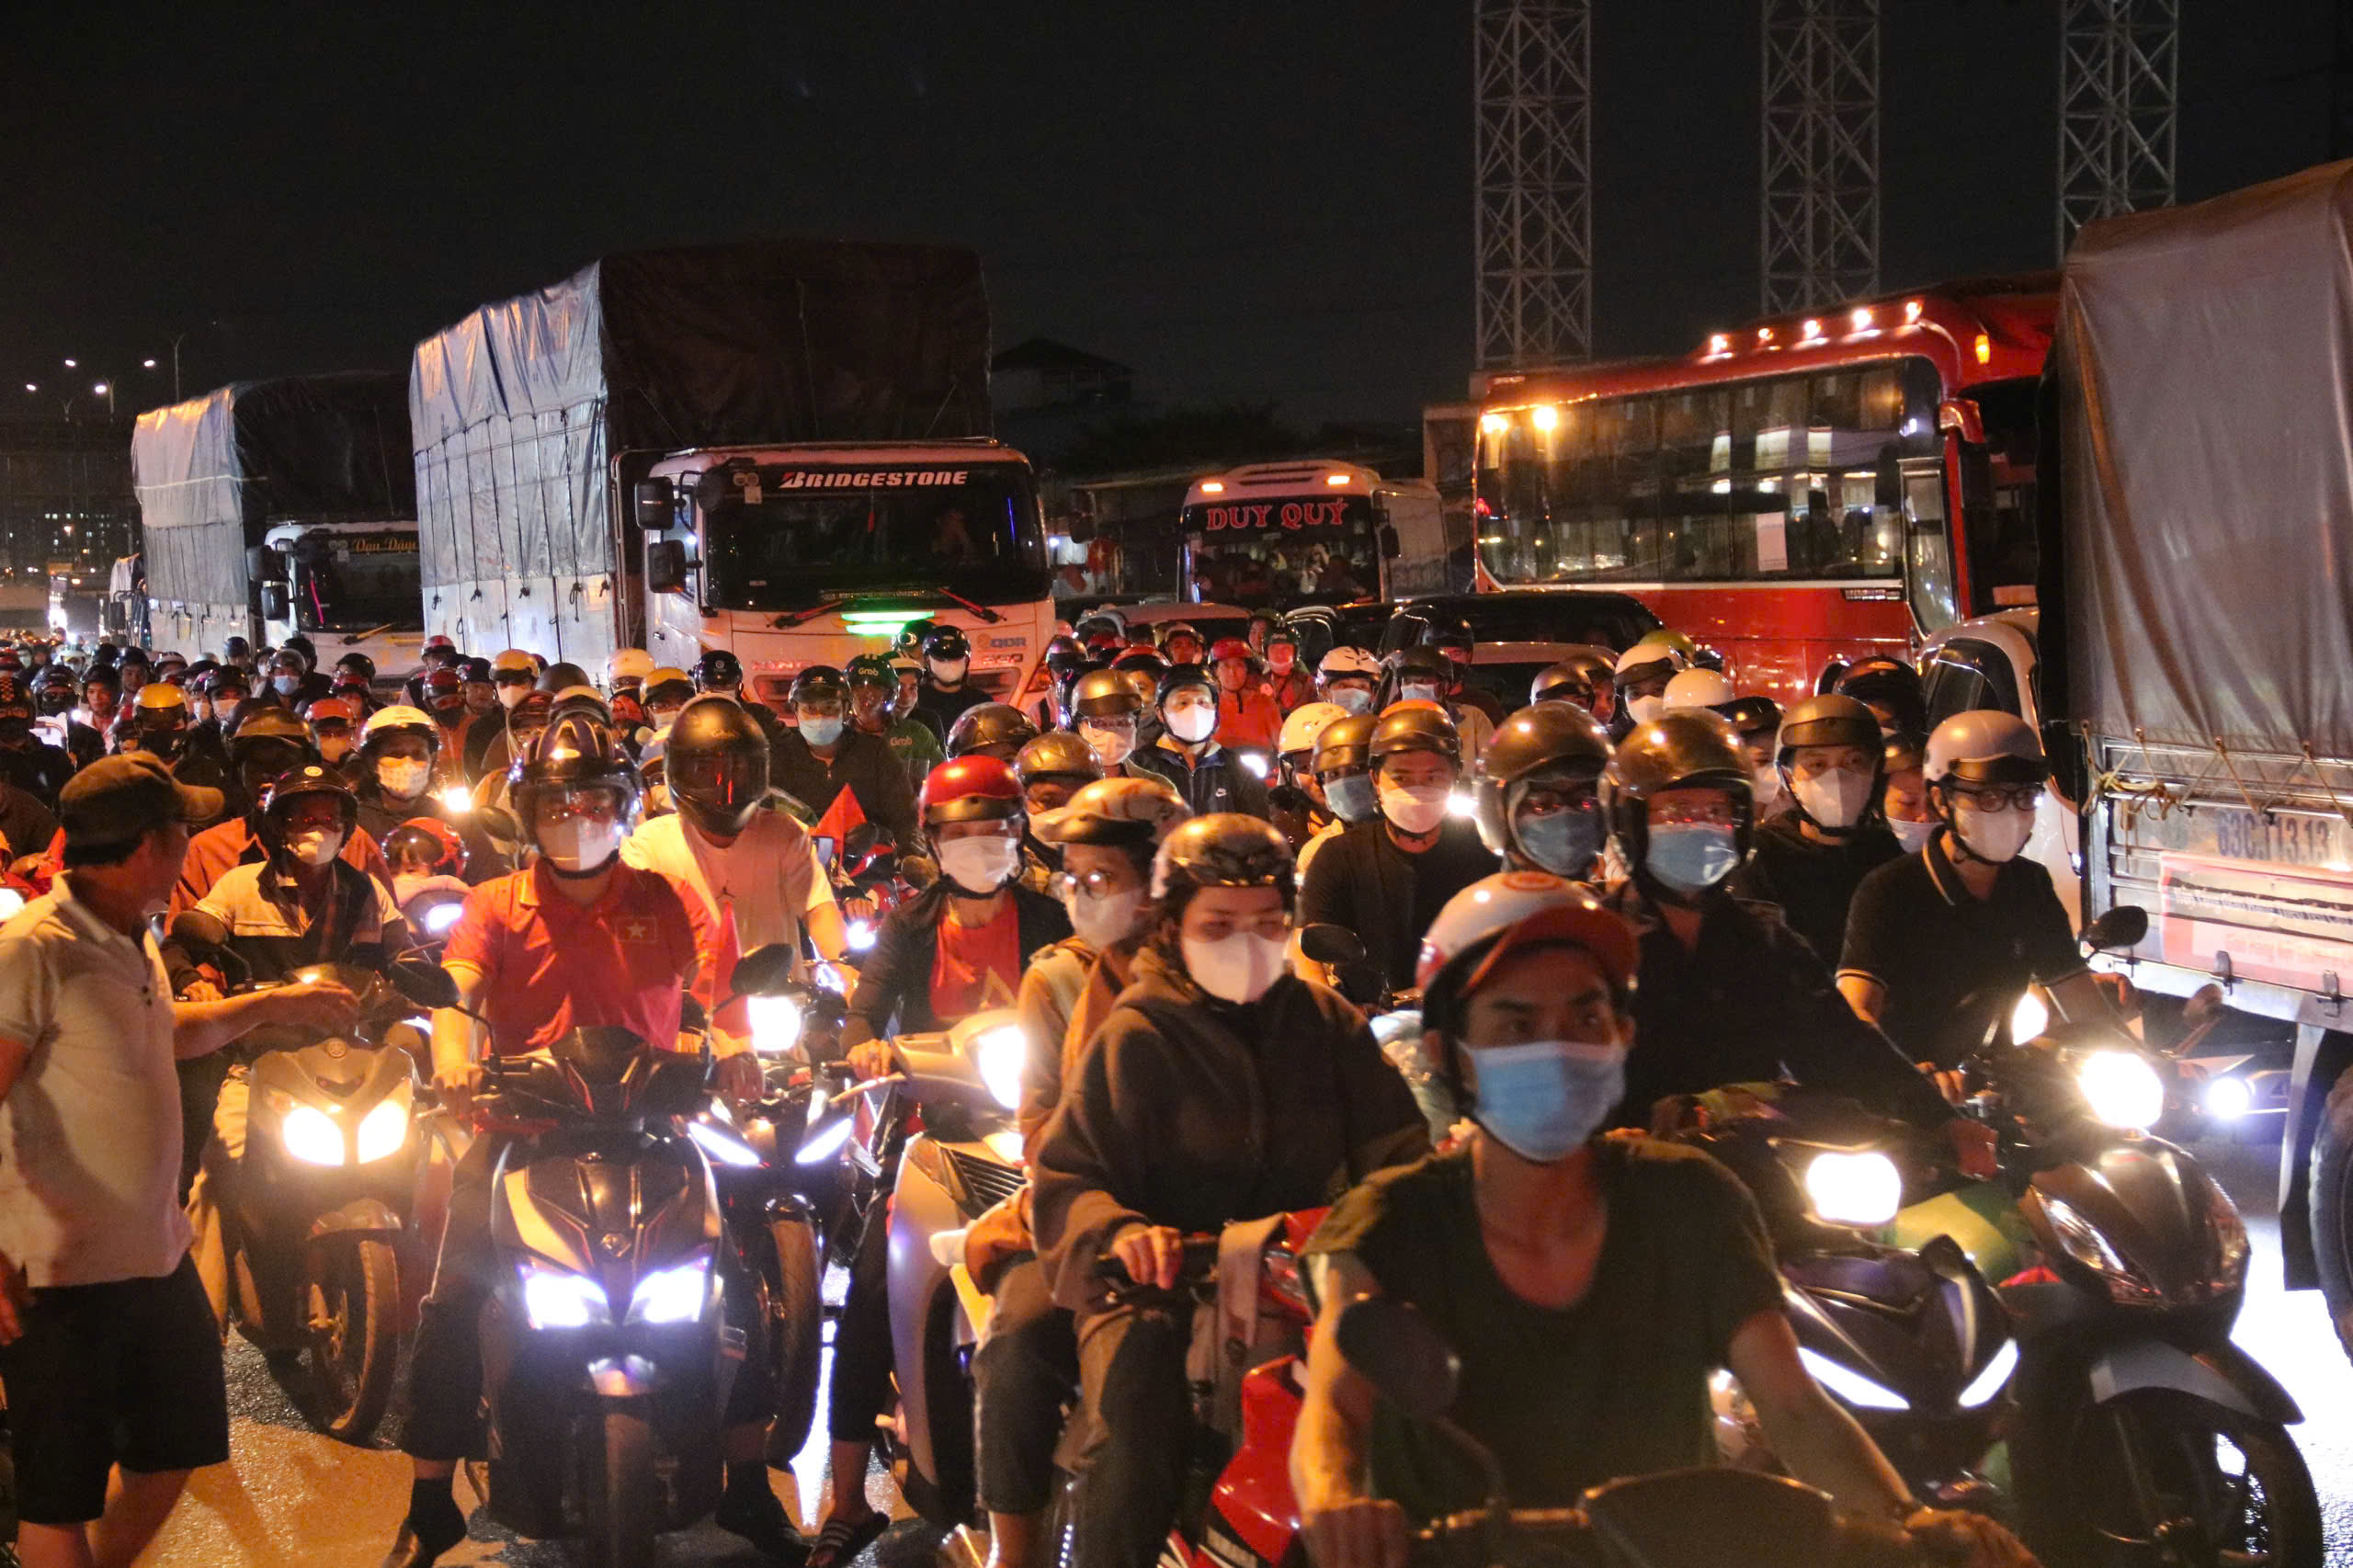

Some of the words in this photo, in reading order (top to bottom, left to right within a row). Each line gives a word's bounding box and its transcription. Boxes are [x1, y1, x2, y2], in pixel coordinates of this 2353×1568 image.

[779, 472, 968, 488] BRIDGESTONE
[1206, 506, 1272, 530] DUY
[858, 667, 880, 676] Grab
[890, 735, 913, 746] Grab
